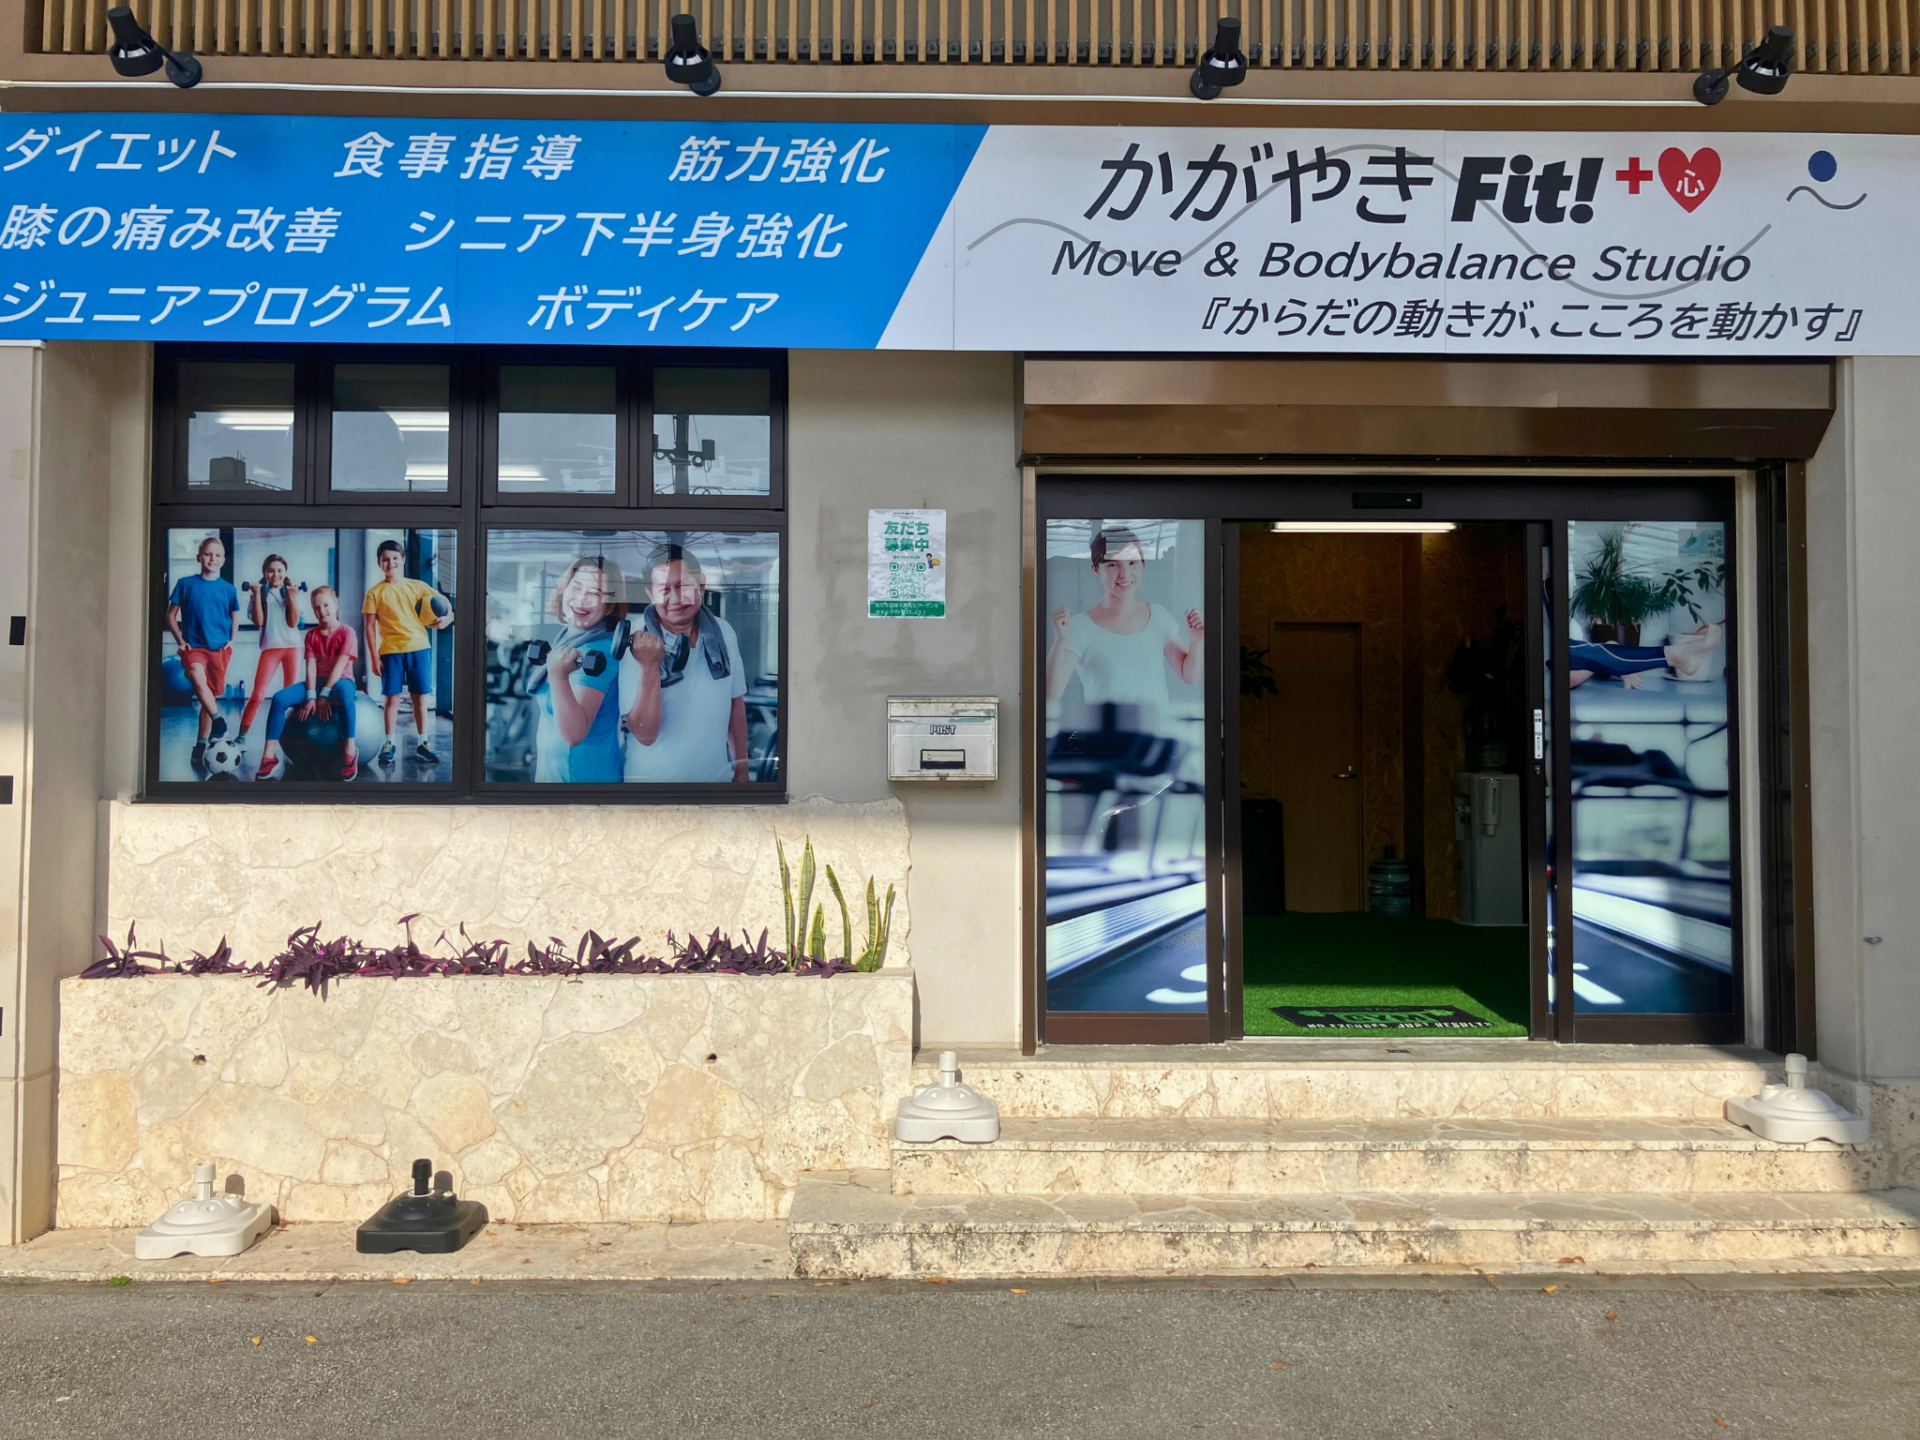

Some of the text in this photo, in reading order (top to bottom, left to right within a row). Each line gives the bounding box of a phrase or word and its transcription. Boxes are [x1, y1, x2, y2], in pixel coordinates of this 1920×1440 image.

[3, 126, 891, 184] ダイエット 食事指導 筋力強化
[1676, 169, 1705, 198] 心
[0, 203, 849, 259] 膝の痛み改善 シニア下半身強化
[1051, 240, 1751, 282] Move & Bodybalance Studio
[0, 279, 781, 332] ジュニアプログラム ボディケア
[884, 521, 930, 536] 友だち
[884, 538, 930, 552] 募集中
[929, 724, 957, 735] POST
